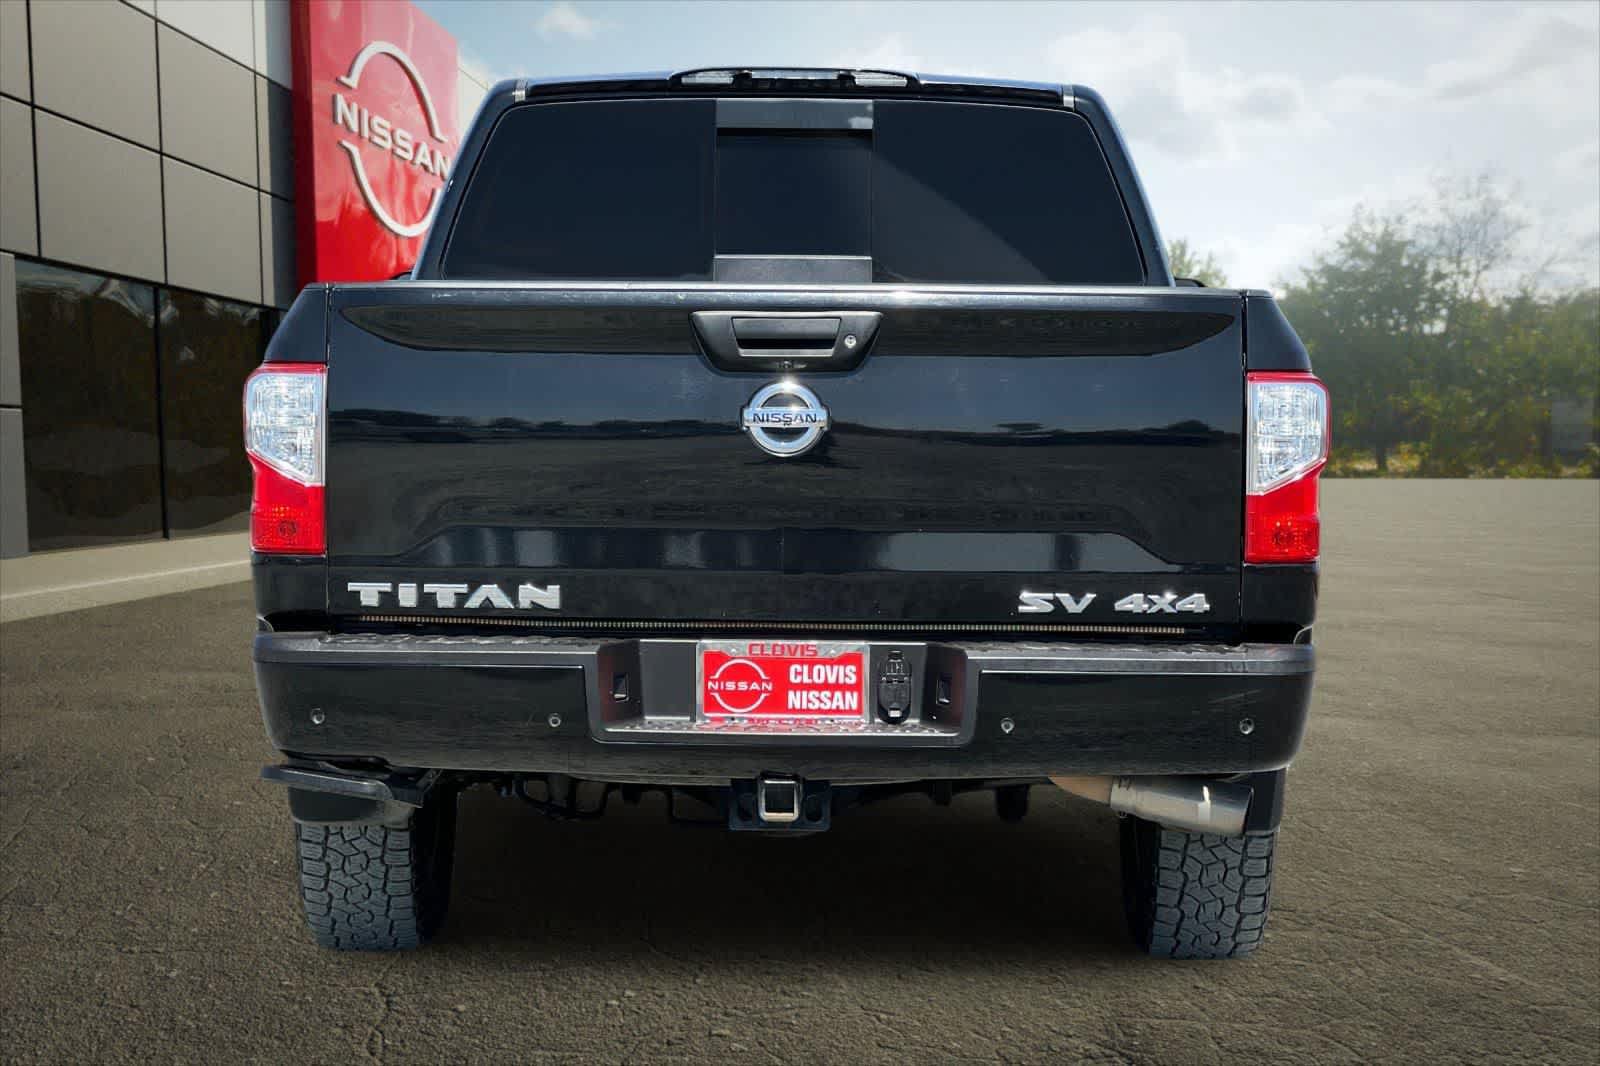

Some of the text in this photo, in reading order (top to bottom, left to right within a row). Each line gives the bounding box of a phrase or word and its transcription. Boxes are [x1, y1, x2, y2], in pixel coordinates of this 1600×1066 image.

[333, 92, 450, 181] NISSAN
[752, 412, 817, 424] NISSAN
[347, 582, 561, 609] TITAN
[1018, 591, 1097, 613] SV
[748, 643, 818, 657] CLOVIS
[788, 664, 857, 685] CLOVIS
[707, 680, 773, 691] NISSAN
[787, 691, 858, 710] NISSAN
